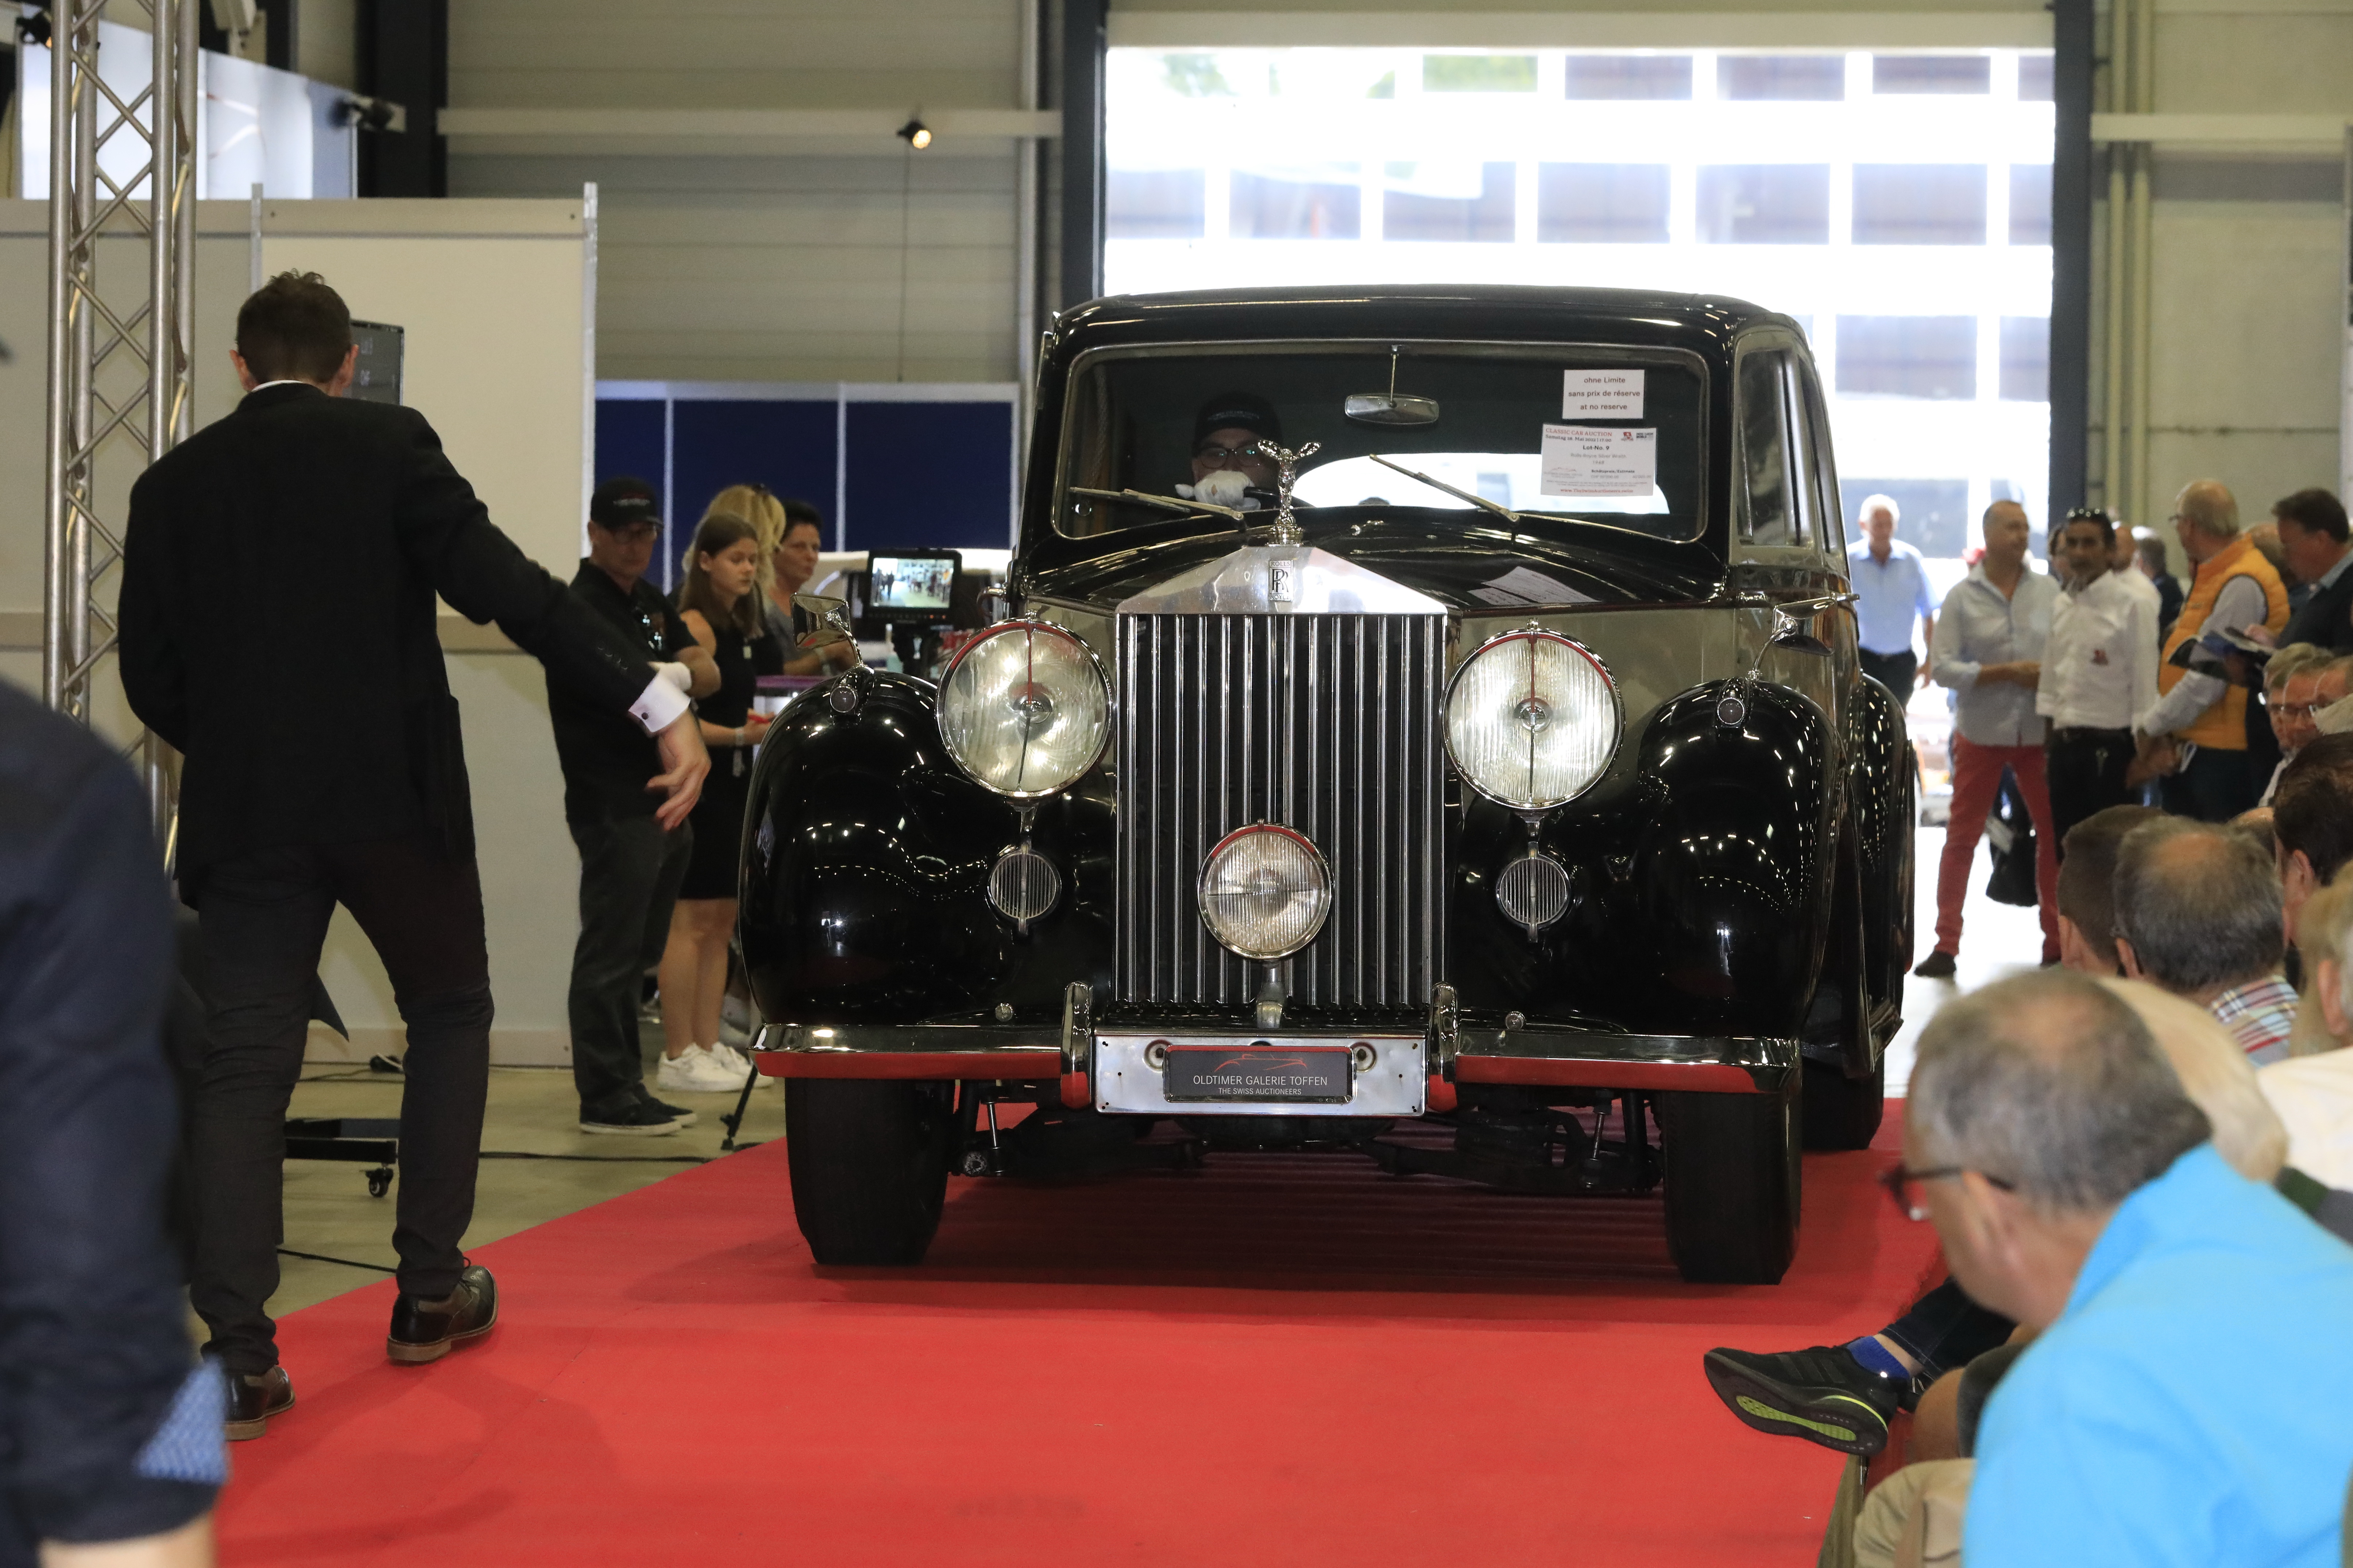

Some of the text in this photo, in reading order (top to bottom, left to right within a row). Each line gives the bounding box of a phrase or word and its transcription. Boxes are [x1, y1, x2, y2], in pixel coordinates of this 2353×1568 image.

[1193, 1075, 1328, 1085] OLDTIMER GALERIE TOFFEN
